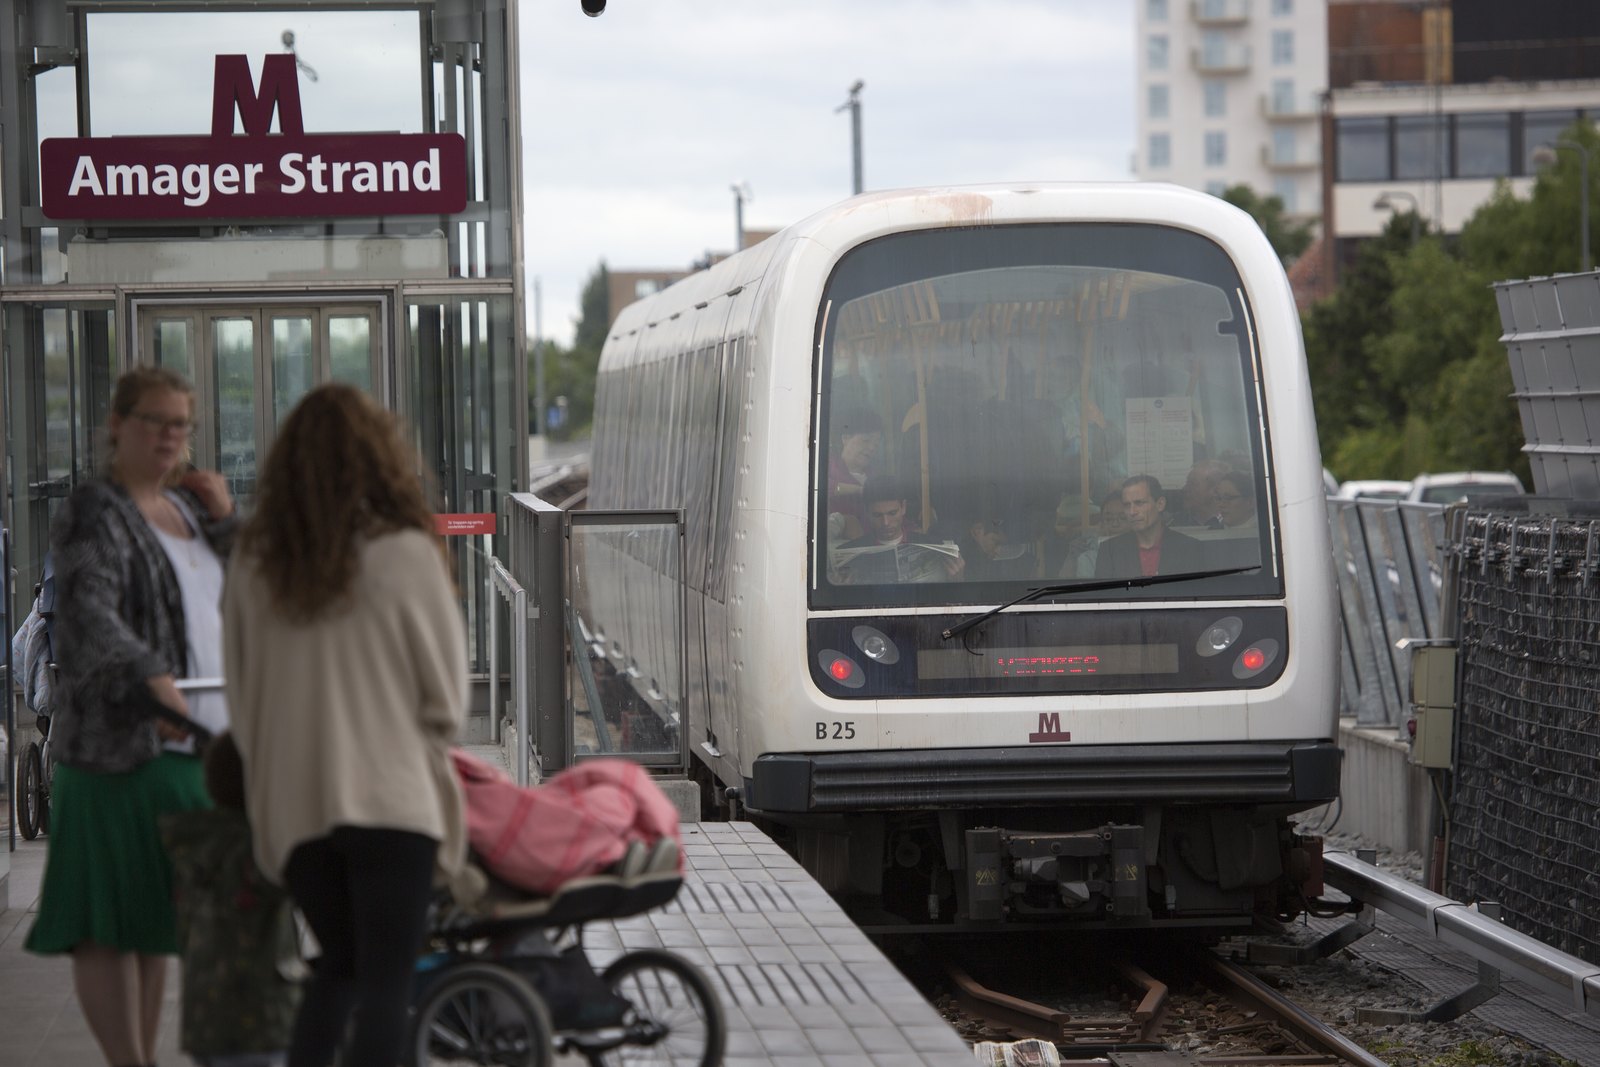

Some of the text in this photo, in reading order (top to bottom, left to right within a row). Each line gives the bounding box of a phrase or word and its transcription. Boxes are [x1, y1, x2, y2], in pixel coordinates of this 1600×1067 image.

[211, 54, 304, 135] M
[68, 148, 441, 206] Amager Strand
[815, 721, 856, 740] B 25
[1039, 712, 1061, 733] M
